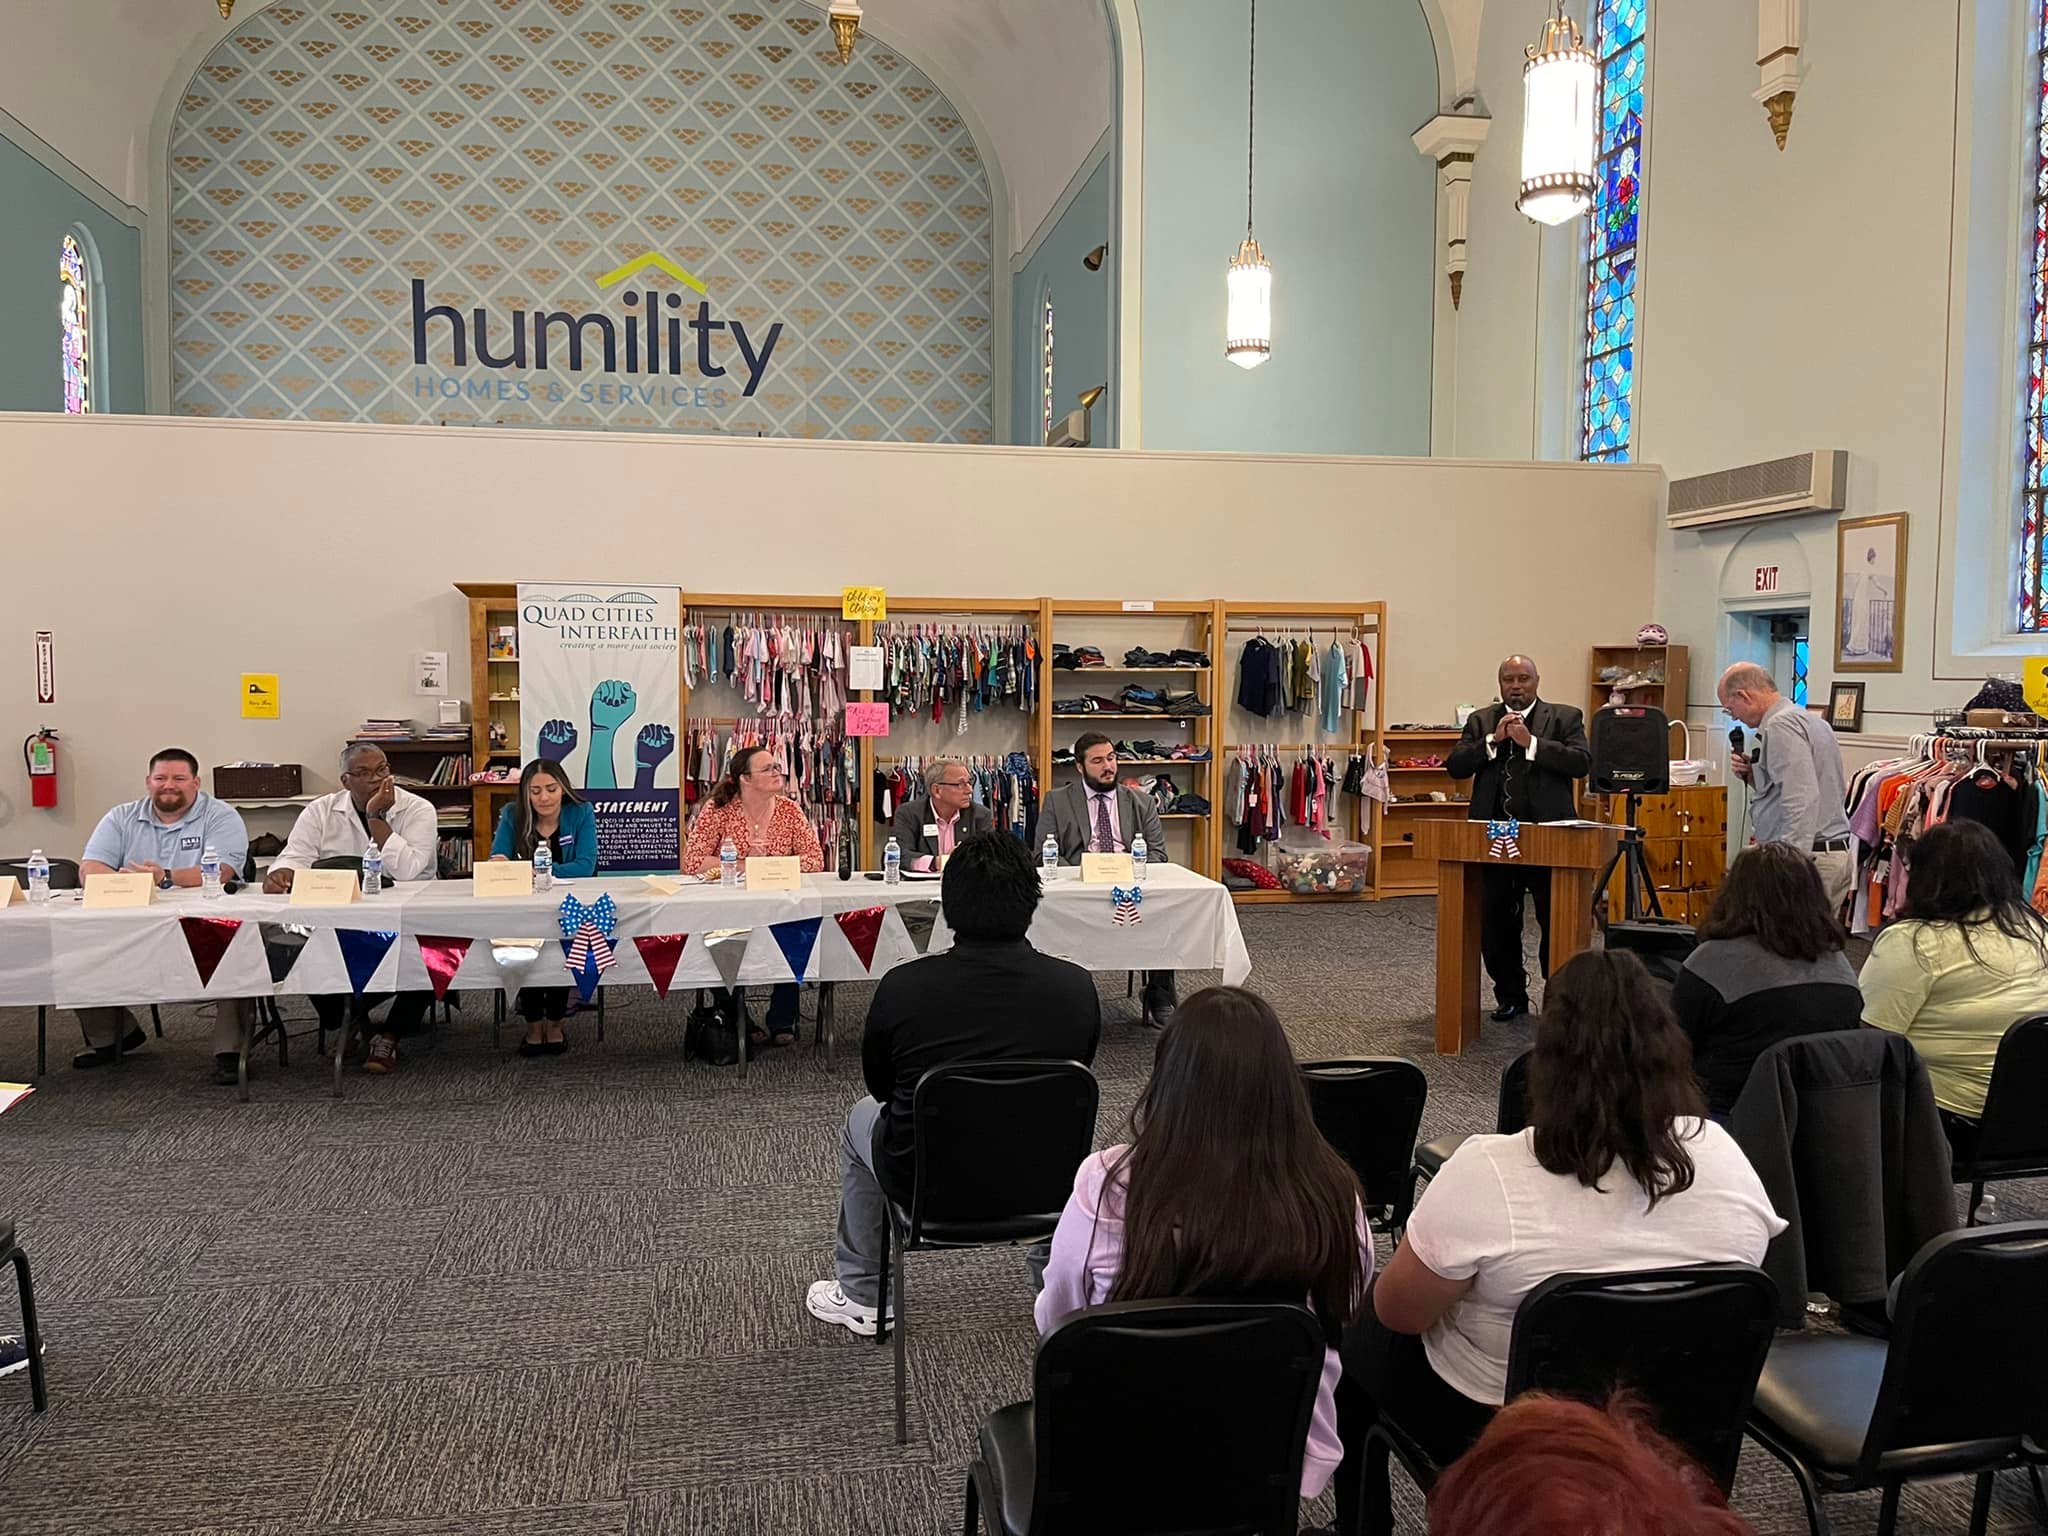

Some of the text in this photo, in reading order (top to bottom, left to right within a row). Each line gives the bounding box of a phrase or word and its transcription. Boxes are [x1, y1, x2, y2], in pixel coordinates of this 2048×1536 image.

[411, 278, 784, 397] humility
[415, 376, 727, 409] HOMES & SERVICES
[1755, 566, 1778, 591] EXIT
[523, 605, 654, 628] QUAD CITIES
[560, 625, 677, 641] INTERFAITH
[559, 642, 596, 651] creating
[630, 643, 647, 651] just
[649, 643, 677, 652] society
[593, 801, 669, 813] STATEMENT
